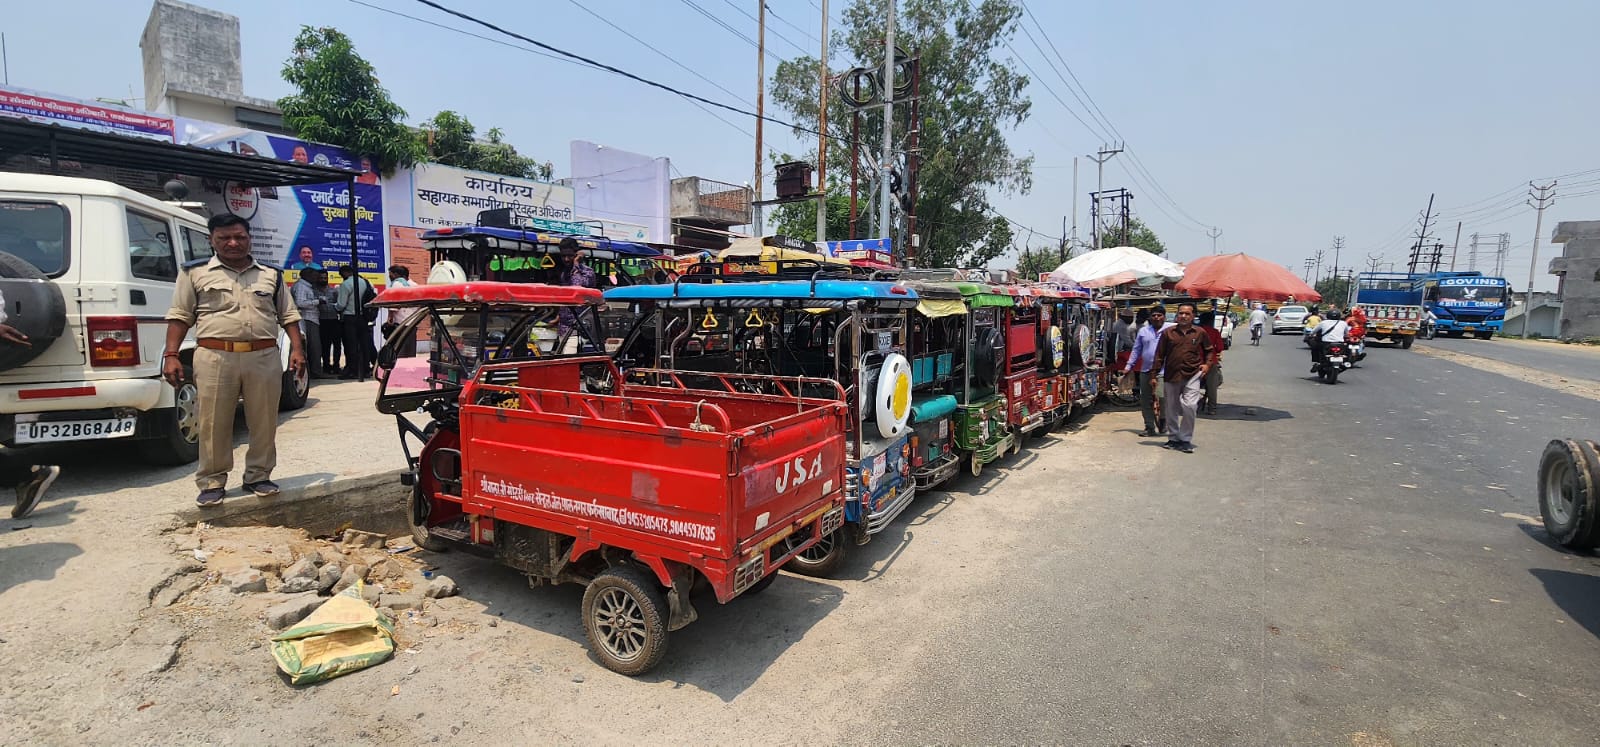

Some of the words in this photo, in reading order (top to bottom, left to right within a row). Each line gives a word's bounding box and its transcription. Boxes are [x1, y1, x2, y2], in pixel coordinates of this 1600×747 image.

[301, 187, 335, 206] स्मार्ट
[464, 176, 533, 199] कार्यालय
[230, 198, 253, 211] सुरक्षा
[417, 189, 460, 206] सहायक
[461, 195, 504, 211] सम्भागीय
[507, 199, 538, 218] परिवहन
[538, 205, 571, 220] अधिकारी
[318, 205, 349, 222] सुरक्षा
[354, 206, 379, 224] ुनिए
[29, 421, 132, 439] UP32BG8448
